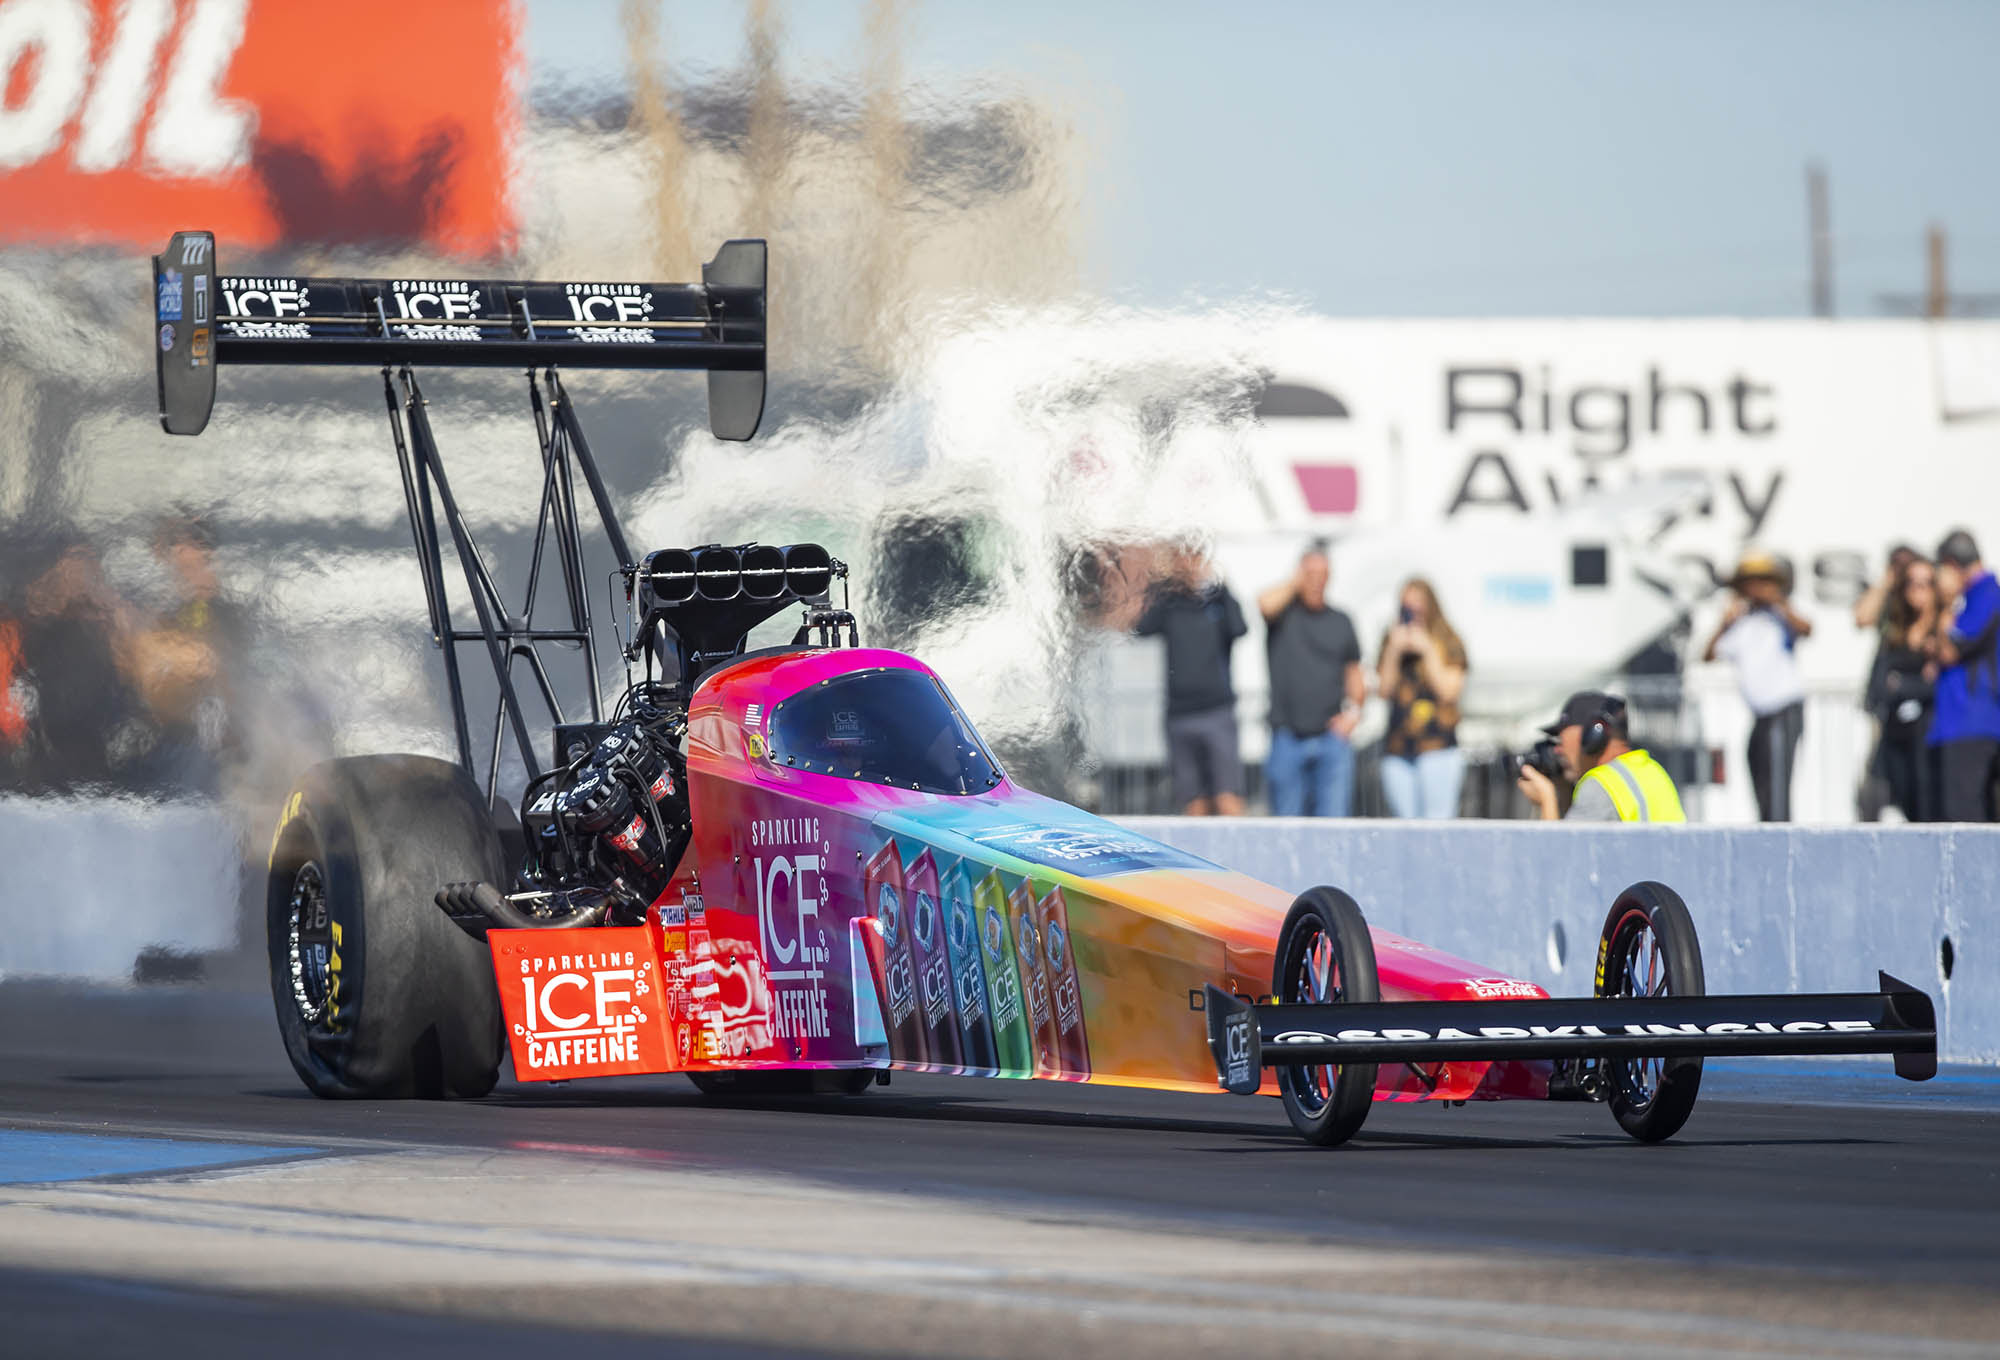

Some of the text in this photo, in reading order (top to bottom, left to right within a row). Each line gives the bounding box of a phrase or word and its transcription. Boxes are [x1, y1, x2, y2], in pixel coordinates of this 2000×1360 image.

[221, 279, 297, 290] SPARKLING
[392, 281, 468, 293] SPARKLING
[565, 284, 641, 296] SPARKLING
[223, 291, 299, 322] ICE
[394, 293, 470, 324] ICE
[568, 295, 643, 326] ICE
[1445, 366, 1777, 458] Right
[571, 775, 600, 796] MSD
[752, 817, 819, 846] SPARKLING
[754, 854, 823, 963] ICE
[521, 952, 634, 974] SPARKLING
[886, 953, 910, 1006] ICE
[922, 957, 946, 1008] ICE
[957, 961, 979, 1010] ICE
[991, 967, 1014, 1013] ICE
[522, 969, 637, 1031] ICE
[765, 989, 831, 1040] CAFFEINE
[528, 1035, 639, 1068] CAFFEINE
[1226, 1022, 1249, 1062] ICE
